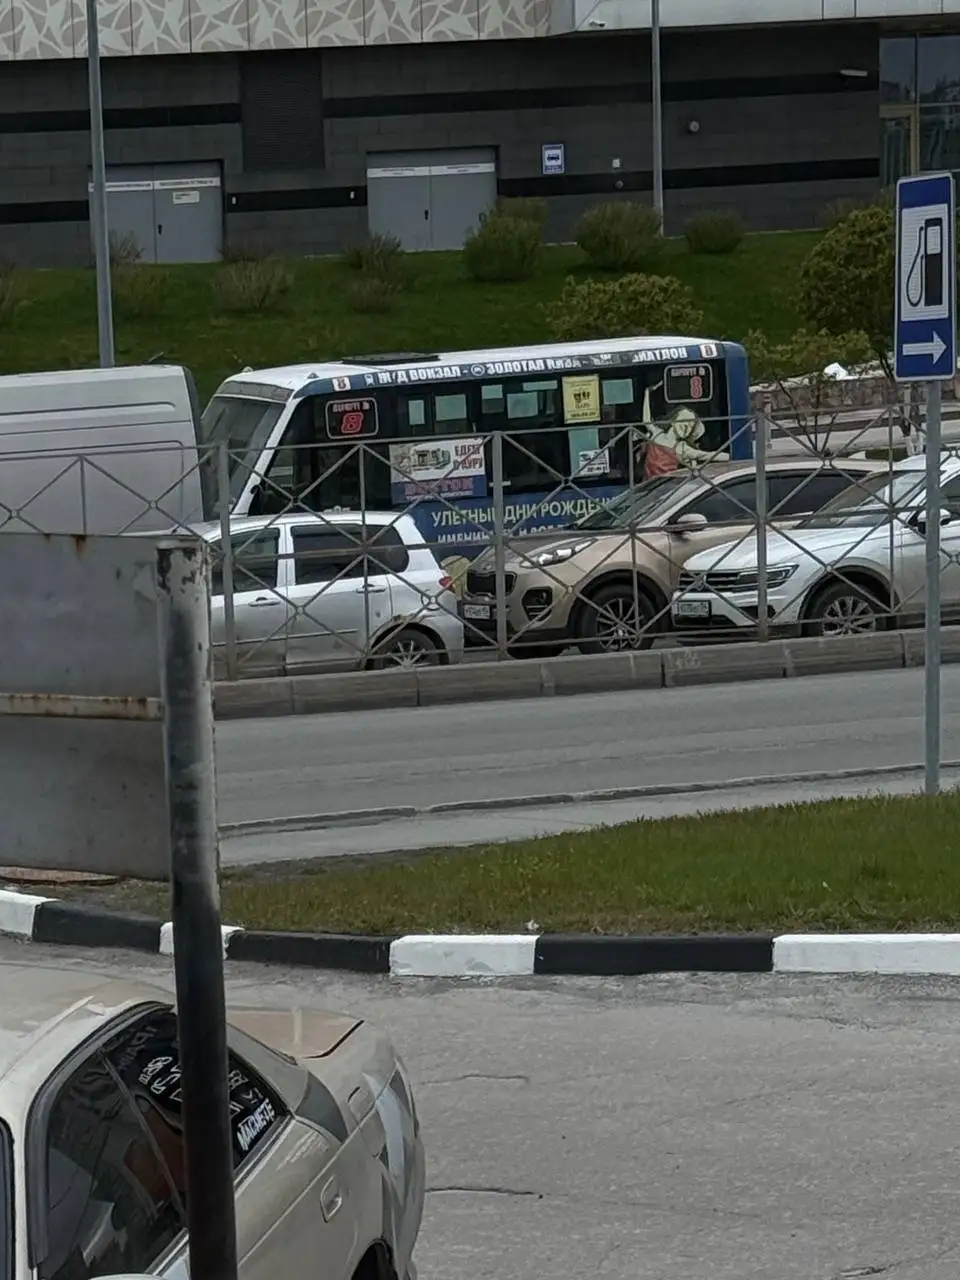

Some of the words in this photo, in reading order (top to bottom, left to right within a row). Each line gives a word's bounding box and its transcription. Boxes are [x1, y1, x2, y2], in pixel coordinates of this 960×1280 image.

[410, 365, 461, 382] ВОКЗАЛ
[486, 359, 543, 375] ЗОЛОТАЯ
[690, 375, 703, 400] 8
[341, 412, 363, 433] 8
[503, 503, 537, 523] ДНИ
